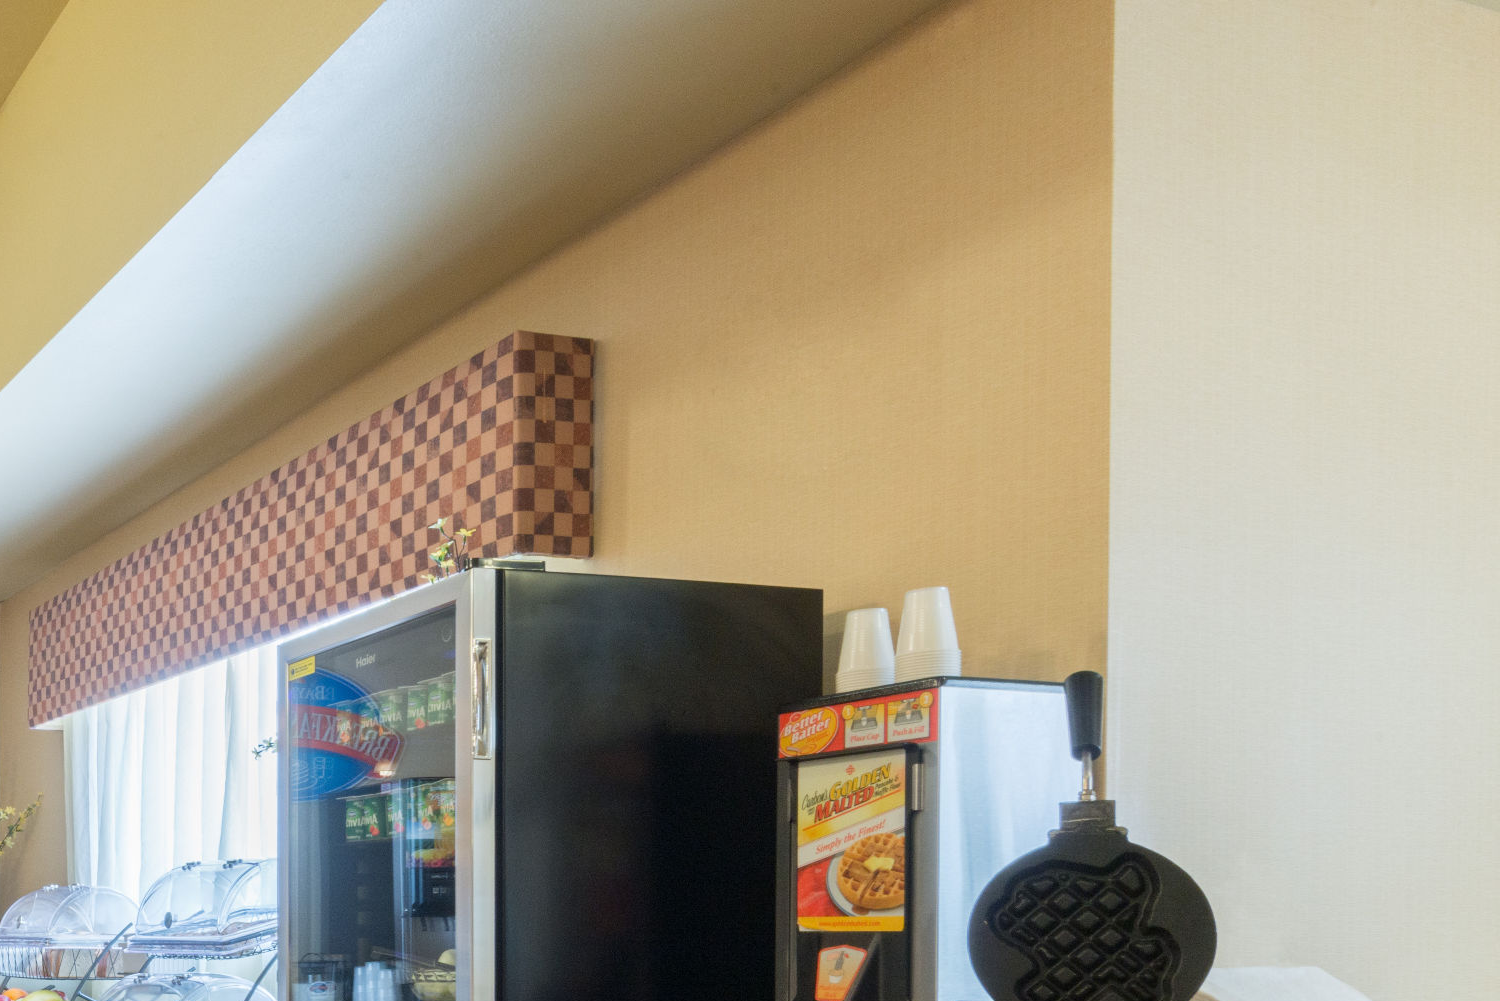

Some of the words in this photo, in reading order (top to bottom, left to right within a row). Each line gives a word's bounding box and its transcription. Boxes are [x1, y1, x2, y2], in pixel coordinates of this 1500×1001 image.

[355, 653, 376, 669] Haier
[784, 710, 825, 737] Better
[791, 718, 831, 744] Batter
[830, 761, 892, 801] GOLDEN
[813, 785, 875, 823] MALTED
[816, 838, 842, 855] Simply
[843, 831, 857, 843] the
[858, 818, 887, 837] Finest!
